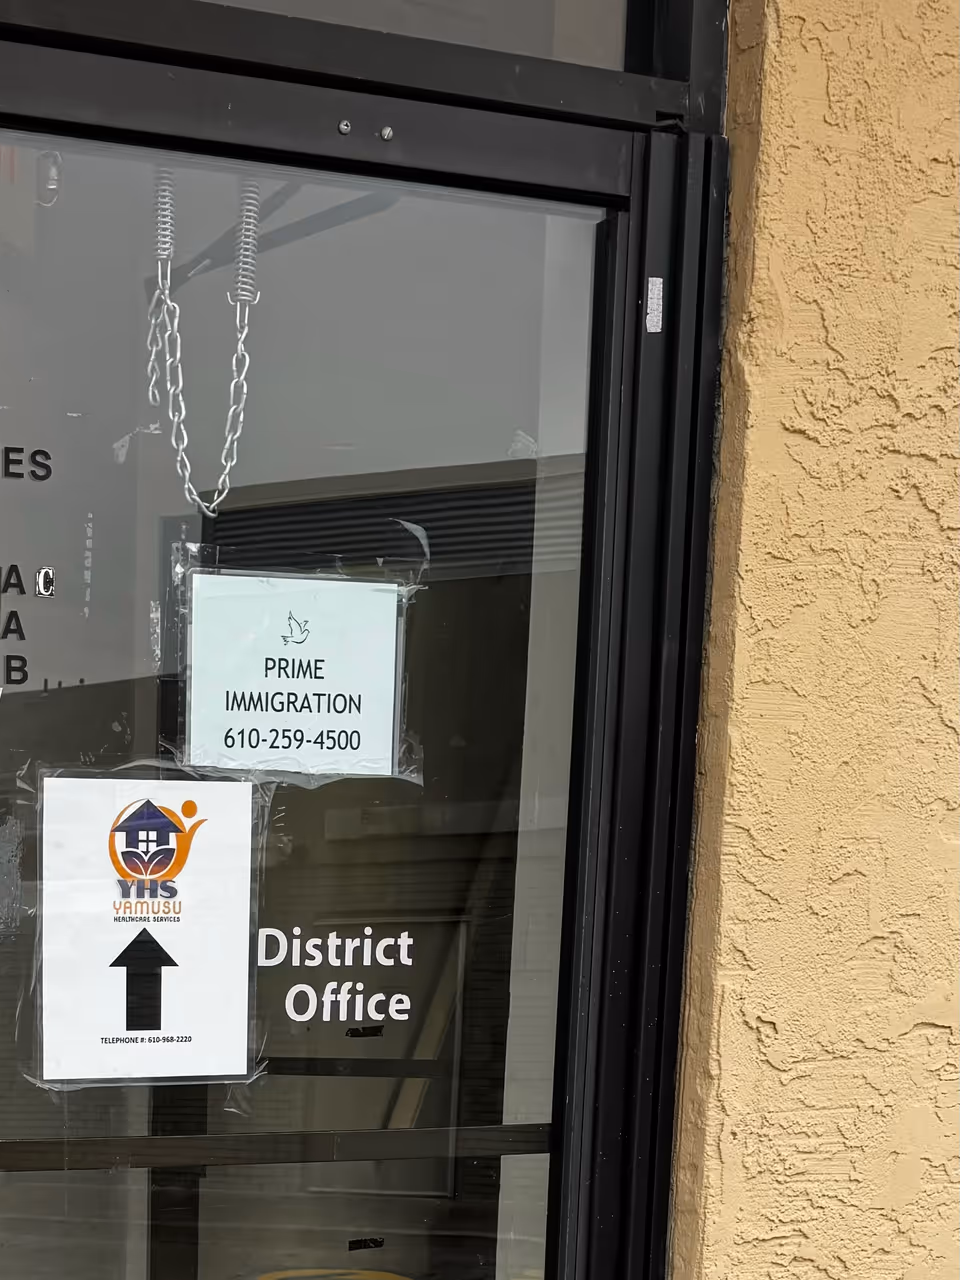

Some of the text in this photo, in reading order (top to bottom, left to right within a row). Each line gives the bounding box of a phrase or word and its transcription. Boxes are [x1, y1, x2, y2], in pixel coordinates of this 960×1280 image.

[264, 657, 325, 680] PRIME
[225, 690, 362, 715] IMMIGRATION
[223, 727, 361, 751] 610-259-4500
[117, 879, 178, 899] YHS
[112, 900, 182, 915] YAMUSU
[113, 915, 181, 923] HEALTHCARE SERVICES
[257, 926, 414, 967] District
[285, 981, 411, 1022] Office
